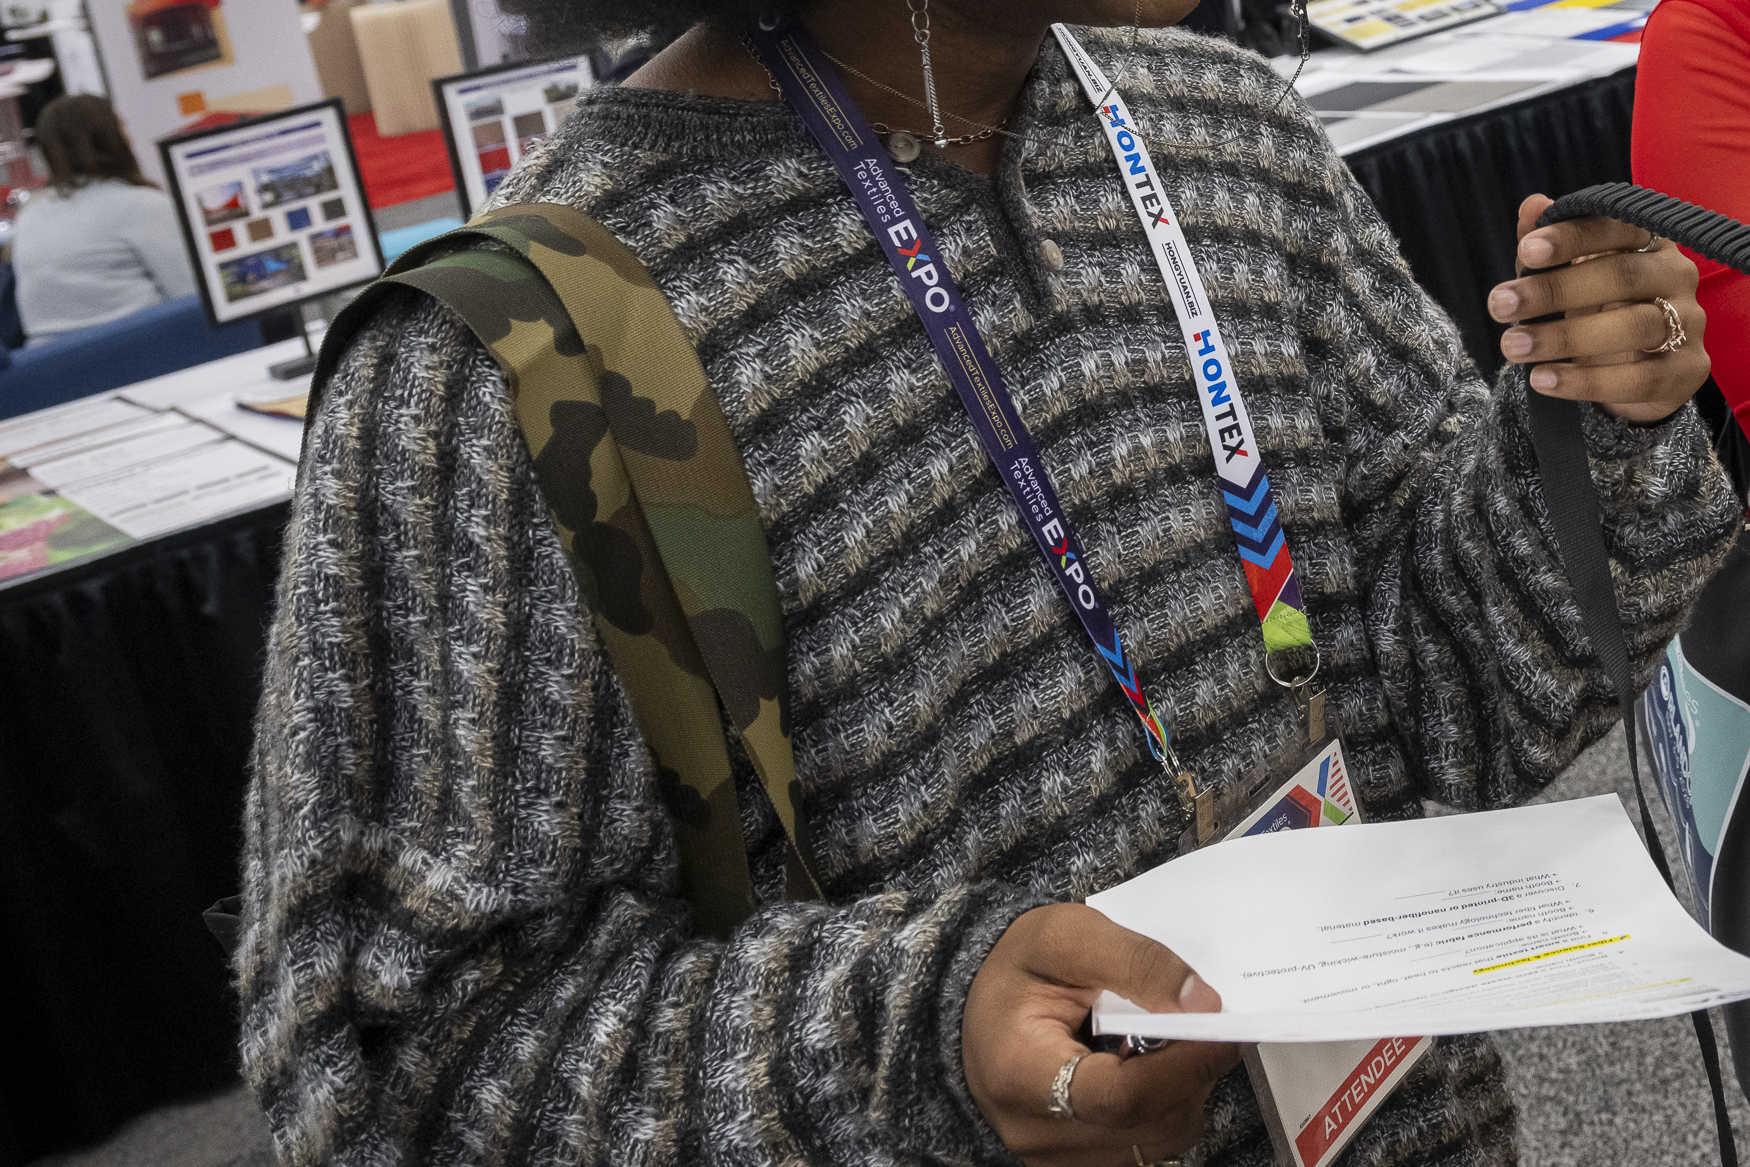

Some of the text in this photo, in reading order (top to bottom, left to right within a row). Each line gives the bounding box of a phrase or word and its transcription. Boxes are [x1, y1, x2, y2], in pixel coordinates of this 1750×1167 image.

[780, 37, 859, 151] AdvancedTextilesExpo.com
[1103, 103, 1170, 229] HONTEX
[852, 160, 891, 223] Textiles
[864, 156, 906, 218] Advanced
[887, 218, 951, 313] EXPO
[1164, 241, 1199, 319] HONGYUAN.BIZ
[948, 324, 1014, 450] AdvancedTextilesExpo.com
[1193, 329, 1249, 464] HONTEX
[1008, 460, 1044, 522] Textiles
[1017, 456, 1054, 518] Advanced
[1041, 517, 1096, 611] EXPO
[1260, 813, 1288, 834] extiles
[1486, 879, 1523, 889] industry
[1525, 873, 1550, 882] What
[1494, 880, 1553, 894] Booth name:
[1524, 885, 1565, 897] Discover
[1461, 895, 1515, 910] 3D-printed
[1515, 906, 1536, 915] fiber
[1538, 900, 1563, 909] What
[1363, 908, 1446, 926] nanofiber-based
[1460, 911, 1512, 925] technology
[1538, 907, 1566, 916] Booth
[1542, 912, 1578, 924] Identify
[1317, 921, 1361, 932] material.
[1387, 930, 1415, 939] work?
[1426, 922, 1457, 932] makes
[1467, 921, 1532, 939] performance
[1435, 936, 1465, 945] fabric
[1465, 937, 1524, 954] application?
[1531, 941, 1560, 951] smart
[1318, 948, 1406, 968] moisture-wicking,
[1496, 949, 1528, 958] textile
[1240, 964, 1315, 979] UV-protective).
[1324, 1035, 1407, 1141] ATTENDEE
